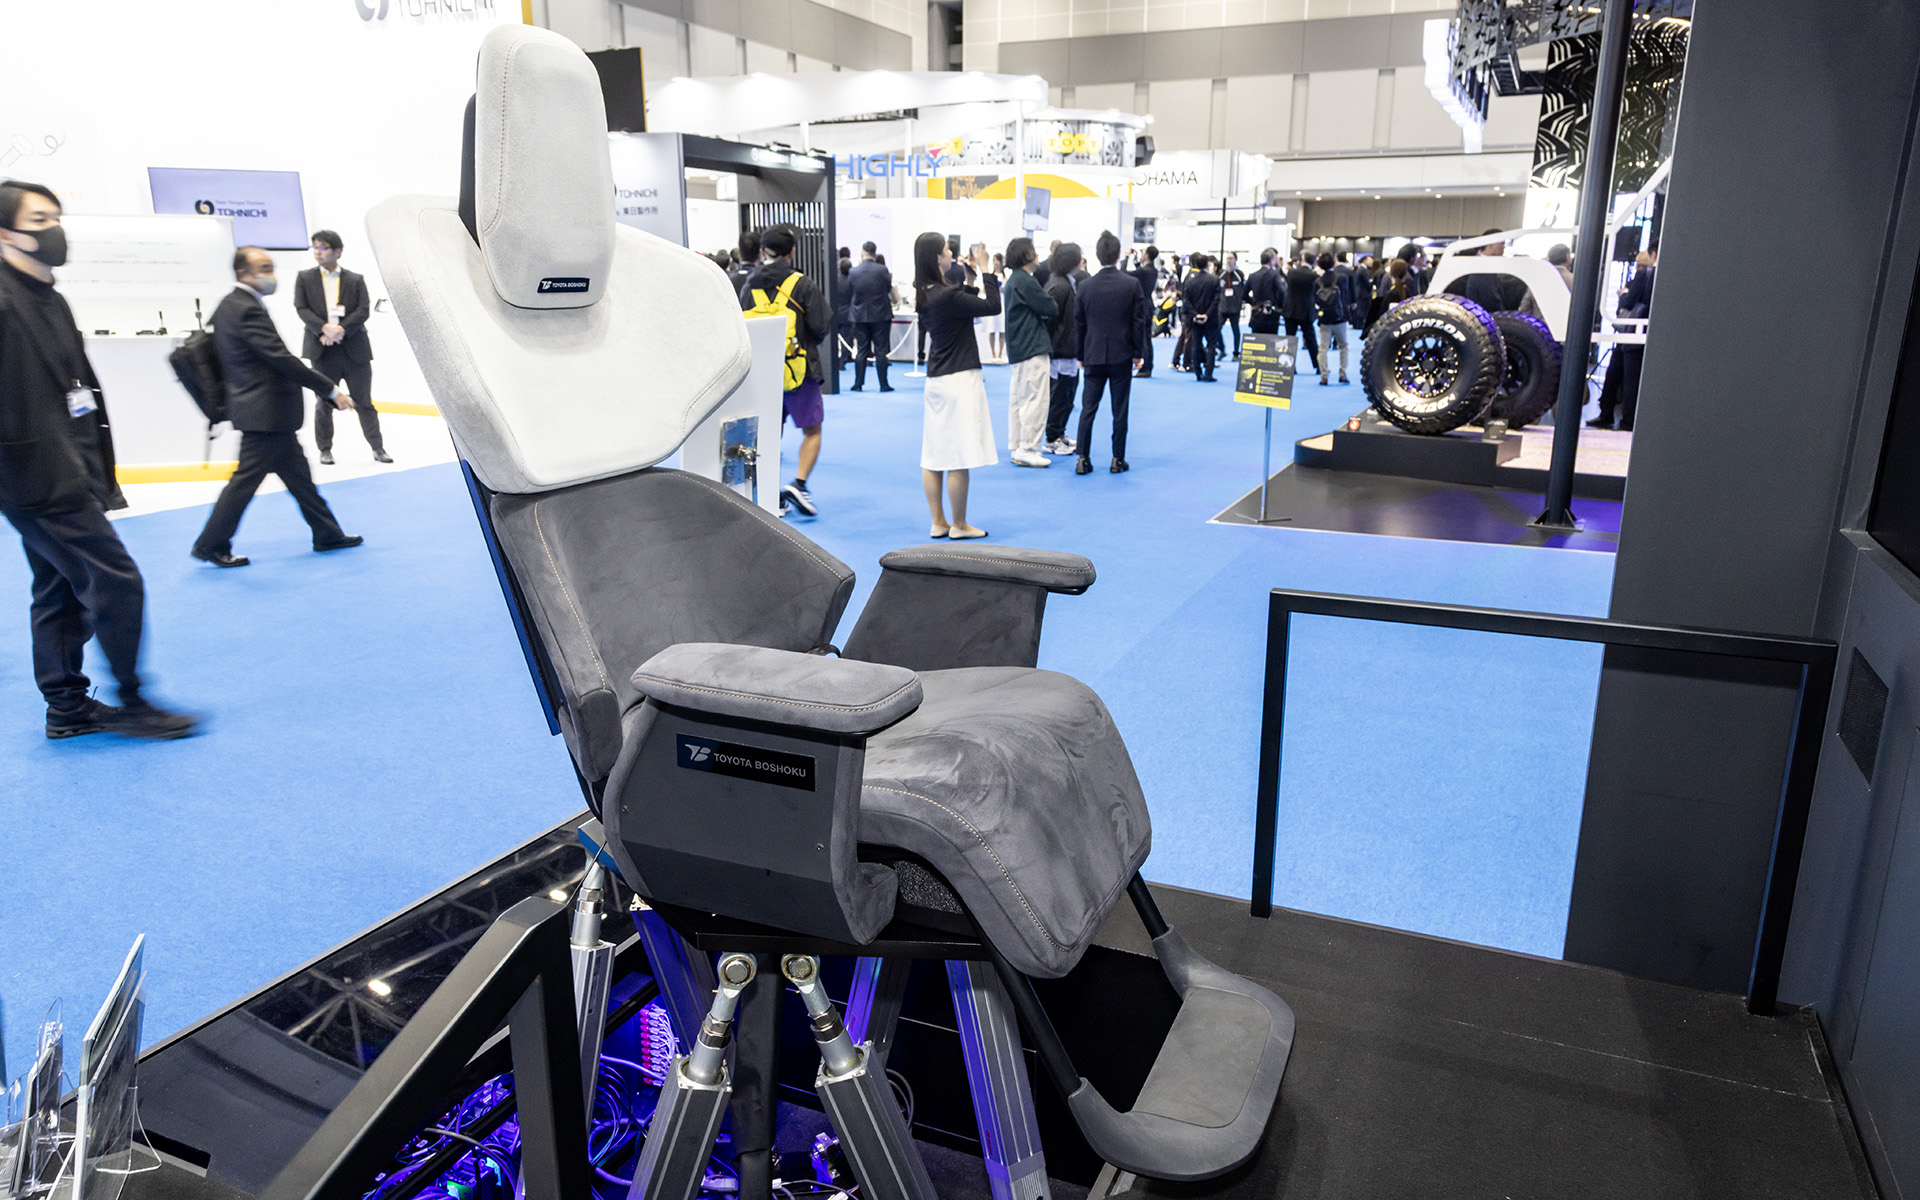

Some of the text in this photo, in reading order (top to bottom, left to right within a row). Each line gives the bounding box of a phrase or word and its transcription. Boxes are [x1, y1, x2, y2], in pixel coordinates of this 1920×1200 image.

[832, 153, 946, 178] HIGHLY
[218, 208, 267, 217] TOHNICHI
[1400, 318, 1467, 342] DUNLOP
[713, 752, 807, 778] TOYOTA BOSHOKU
